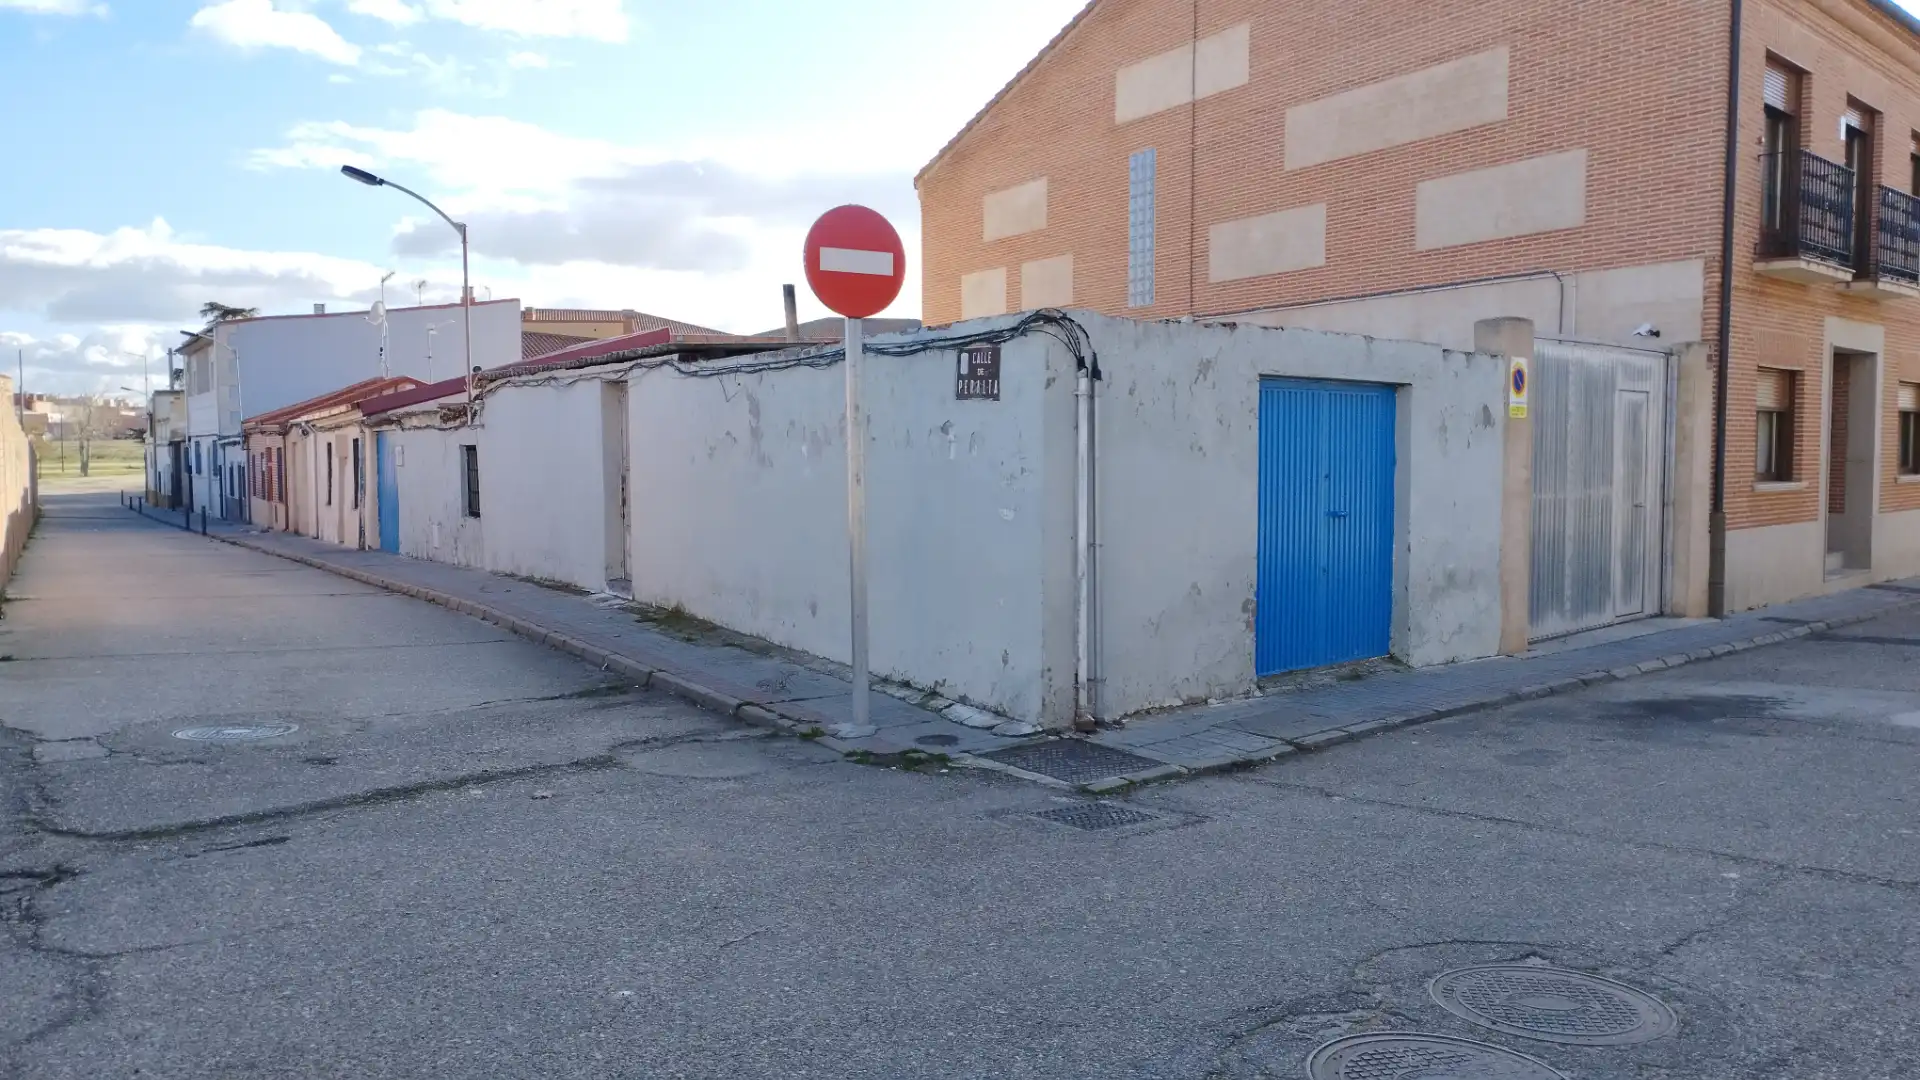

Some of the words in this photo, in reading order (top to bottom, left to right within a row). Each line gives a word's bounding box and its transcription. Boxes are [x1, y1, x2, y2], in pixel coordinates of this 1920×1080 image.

[972, 352, 992, 364] CALLE
[977, 368, 985, 376] DE
[958, 379, 998, 395] PERALTA
